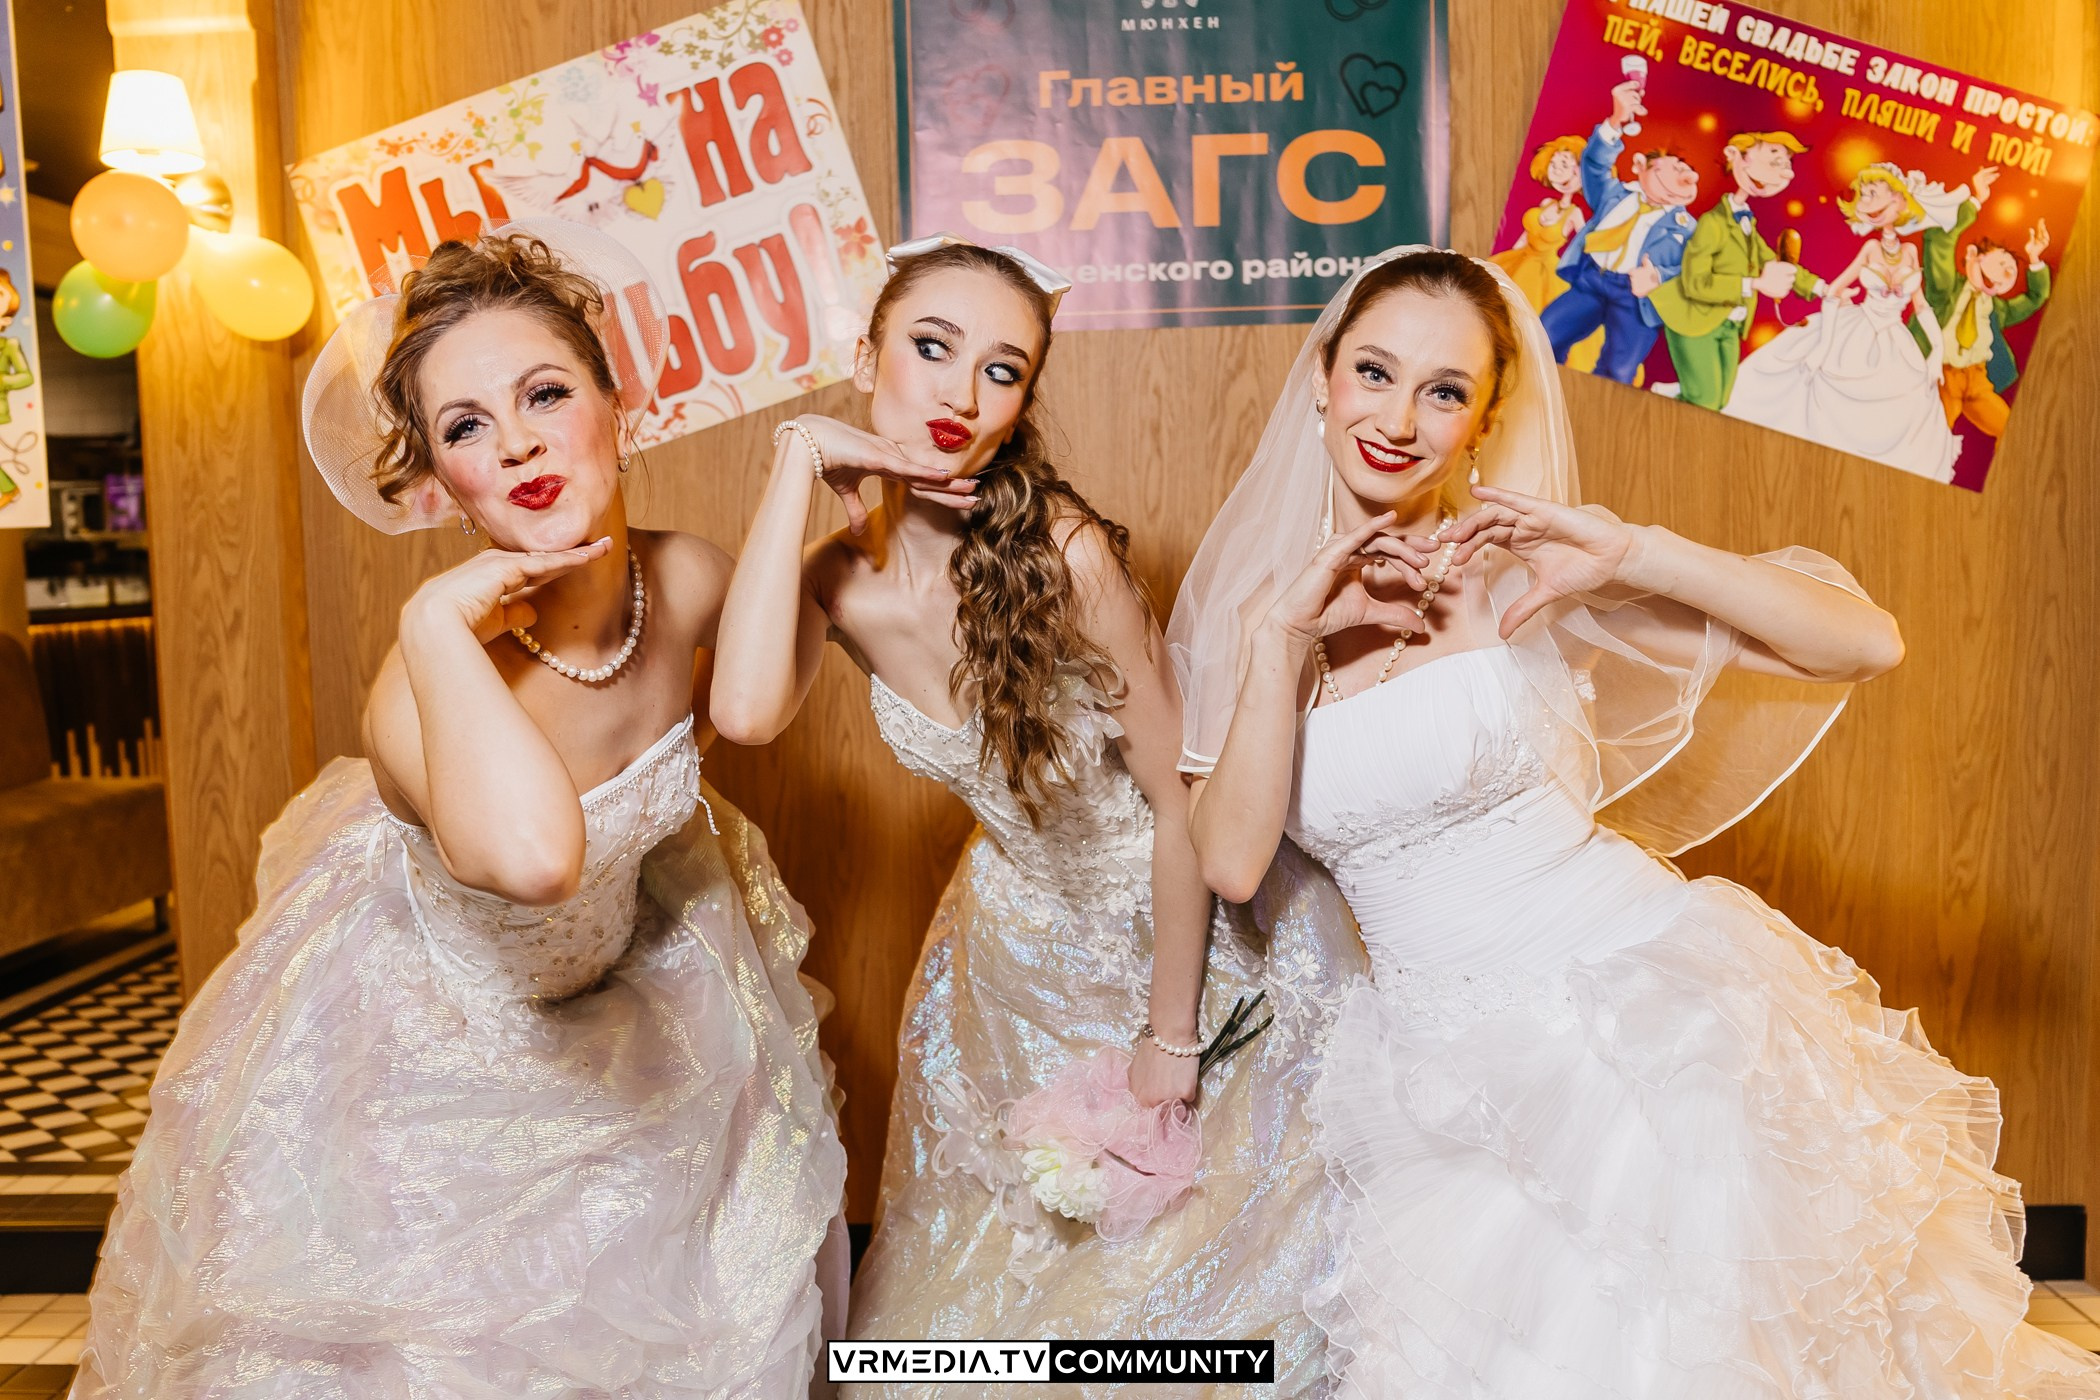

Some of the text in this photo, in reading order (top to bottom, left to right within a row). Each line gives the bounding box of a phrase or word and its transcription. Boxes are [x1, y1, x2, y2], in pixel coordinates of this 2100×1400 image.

[1121, 17, 1219, 31] МЮНХЕН
[1736, 15, 1860, 75] СВАДЬБЕ
[1866, 56, 1959, 107] ЗАКОН
[1038, 61, 1304, 109] Главный
[1603, 15, 2053, 176] ПЕЙ, ВЕСЕЛИСЬ, ПЛЯШИ И ПОЙ!
[960, 129, 1387, 234] ЗАГС
